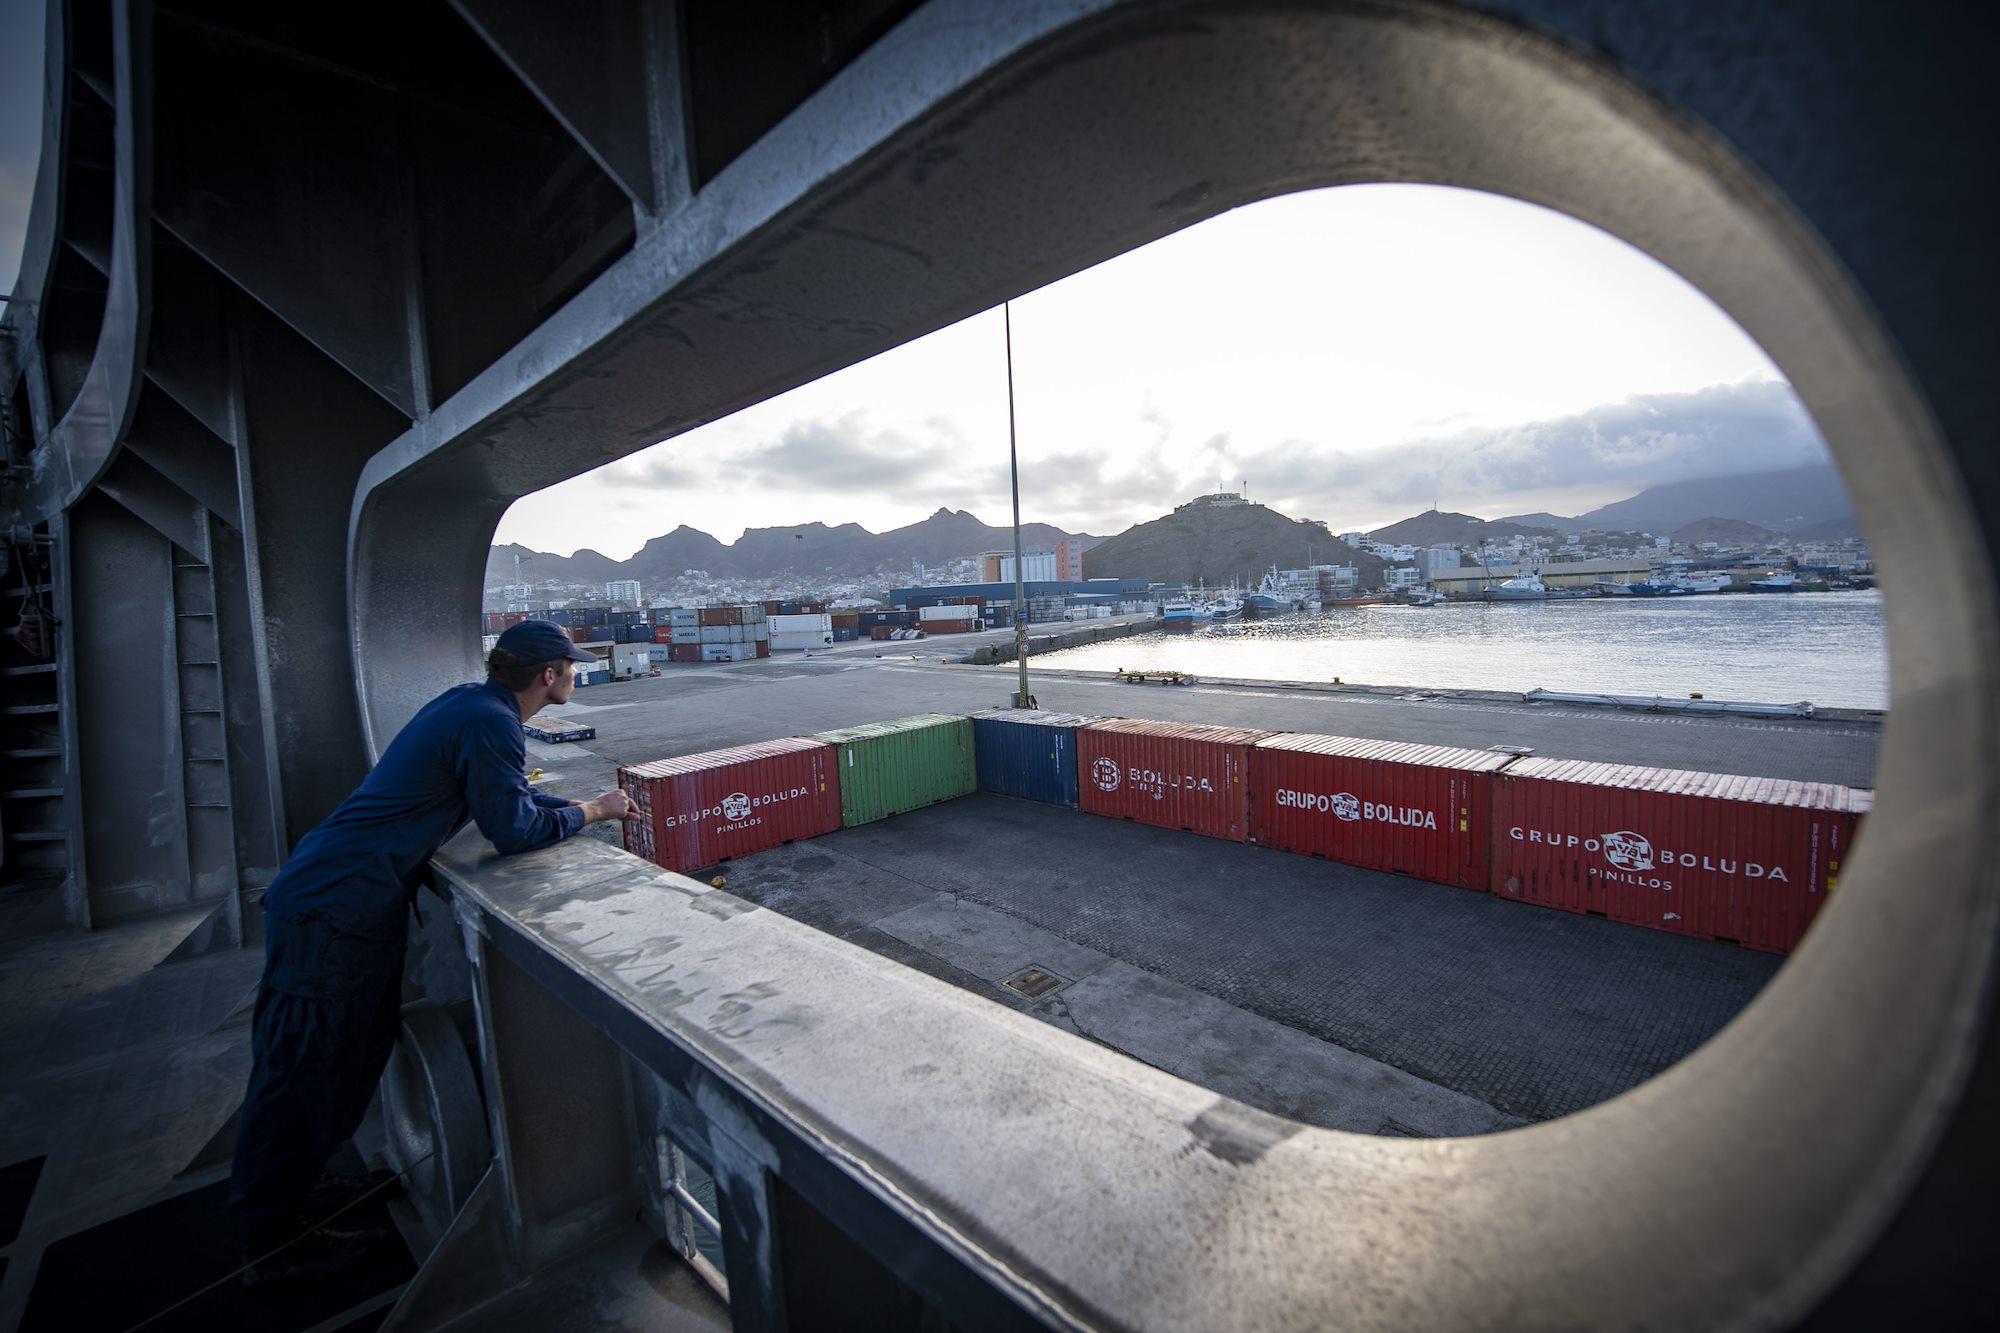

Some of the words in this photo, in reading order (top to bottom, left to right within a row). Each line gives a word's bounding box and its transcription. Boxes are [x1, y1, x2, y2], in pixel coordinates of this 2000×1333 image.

[1130, 767, 1214, 793] BOLUDA
[666, 806, 721, 828] GRUPO
[752, 786, 809, 808] BOLUDA
[1275, 788, 1330, 813] GRUPO
[1363, 801, 1438, 831] BOLUDA
[716, 816, 762, 834] PINILLOS
[1509, 826, 1600, 853] GRUPO
[1660, 849, 1790, 883] BOLUDA
[1589, 867, 1673, 892] PINILLOS
